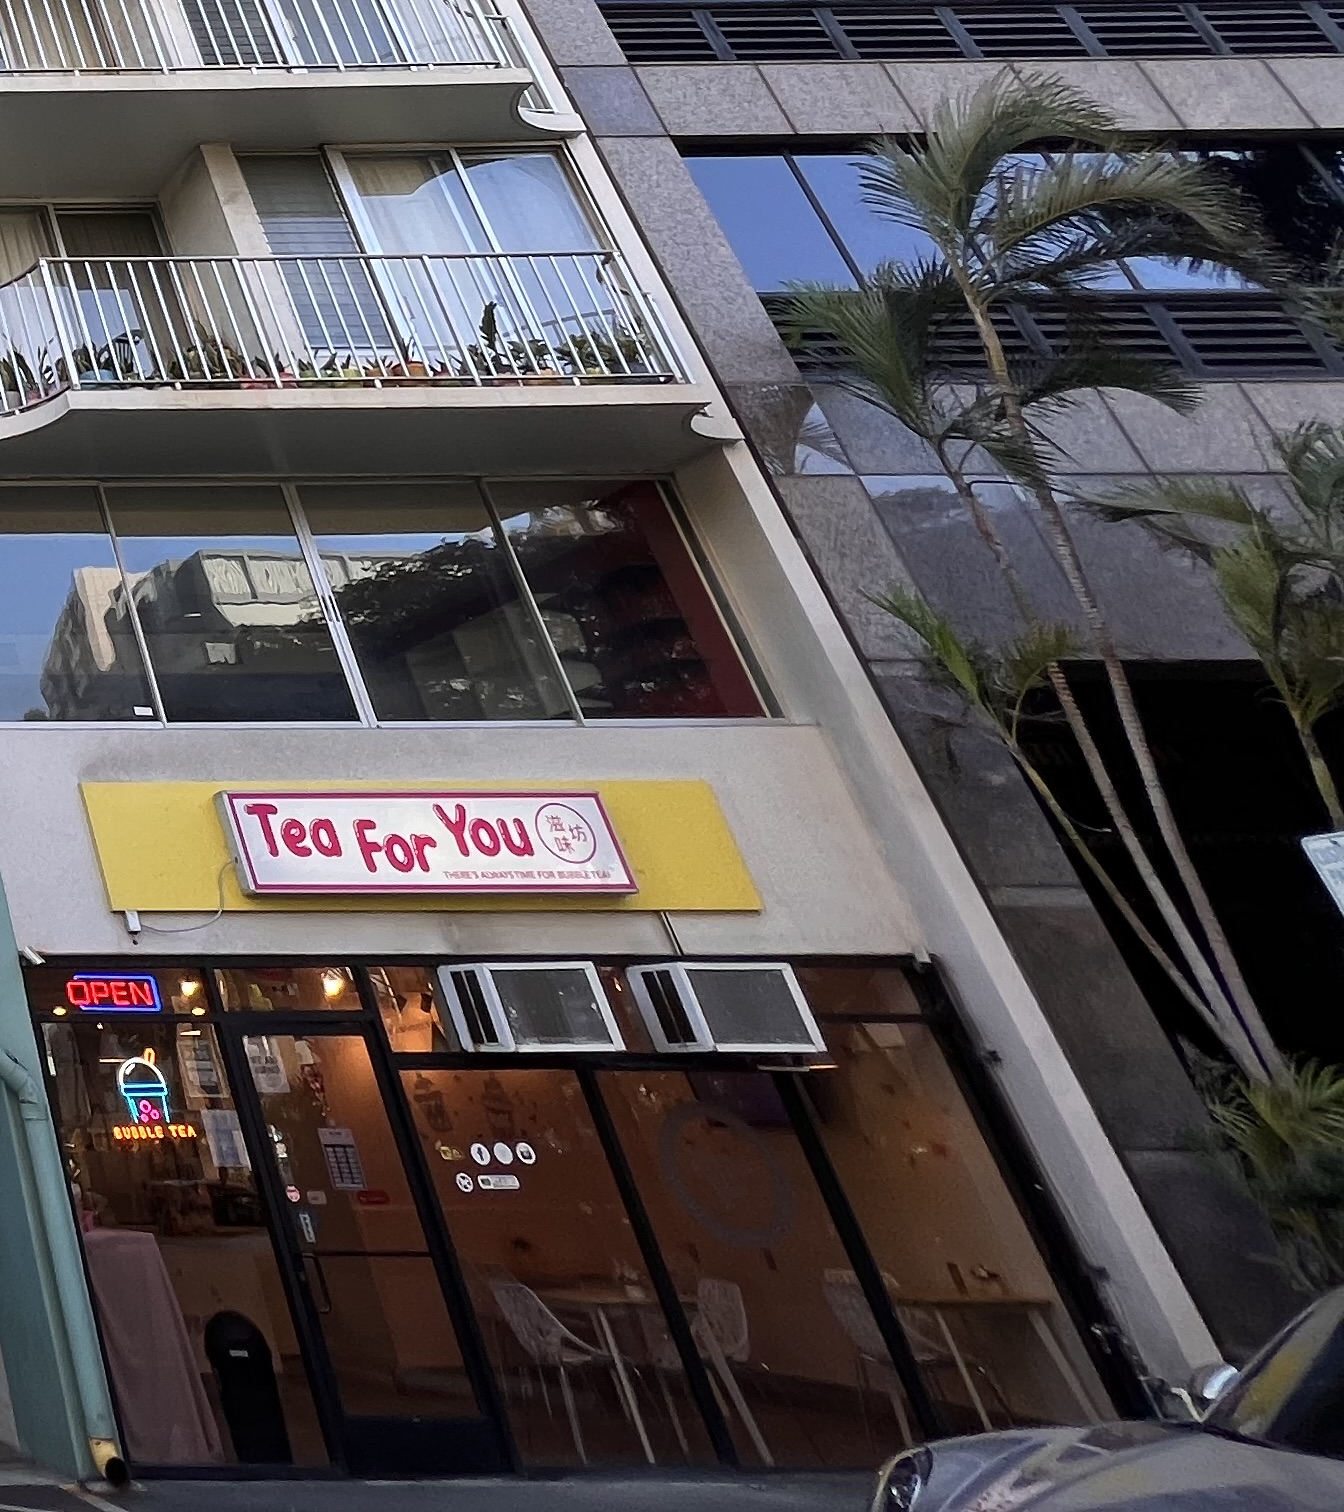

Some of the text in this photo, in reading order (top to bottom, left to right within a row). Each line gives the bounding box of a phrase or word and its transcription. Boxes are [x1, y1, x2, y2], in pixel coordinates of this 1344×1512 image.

[244, 803, 535, 873] Tea For You
[66, 981, 154, 1006] OPEN
[113, 1124, 198, 1140] BUBBLE TEA
